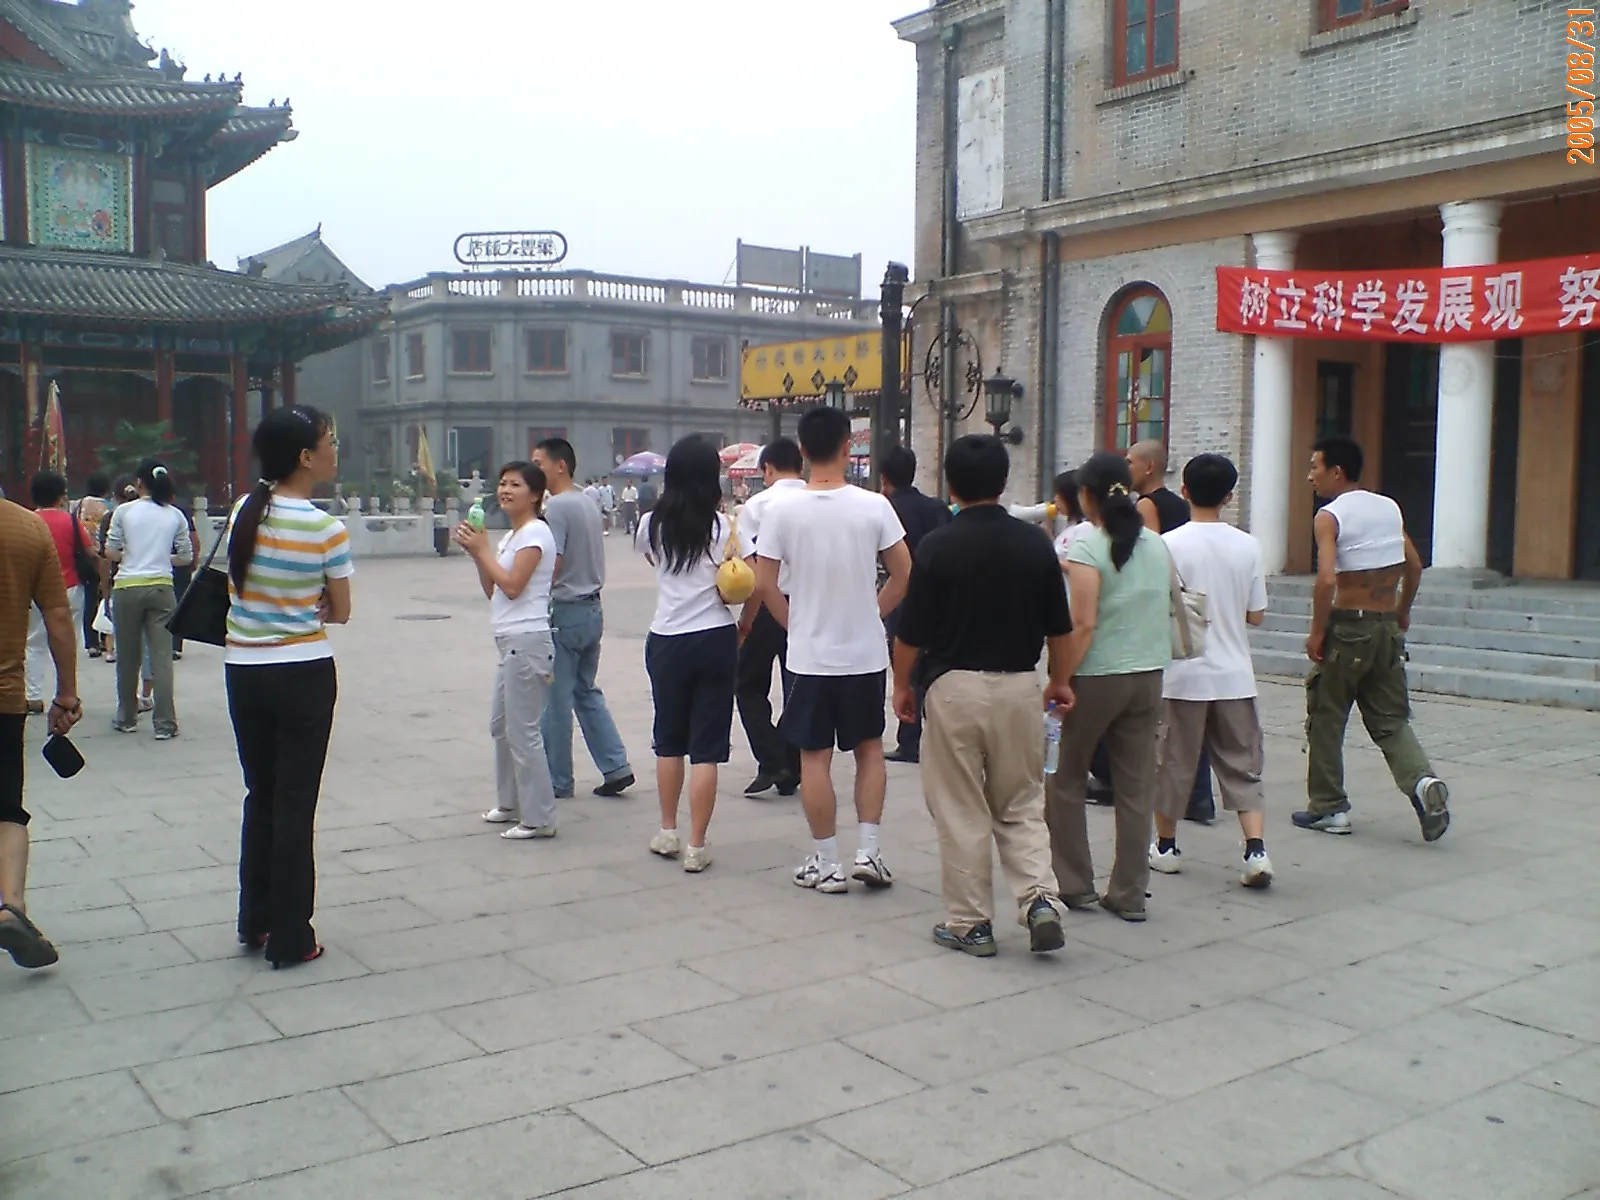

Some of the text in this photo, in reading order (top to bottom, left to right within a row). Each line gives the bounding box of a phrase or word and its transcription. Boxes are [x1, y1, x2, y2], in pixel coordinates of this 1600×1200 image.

[1239, 271, 1524, 335] 树立科学发展观
